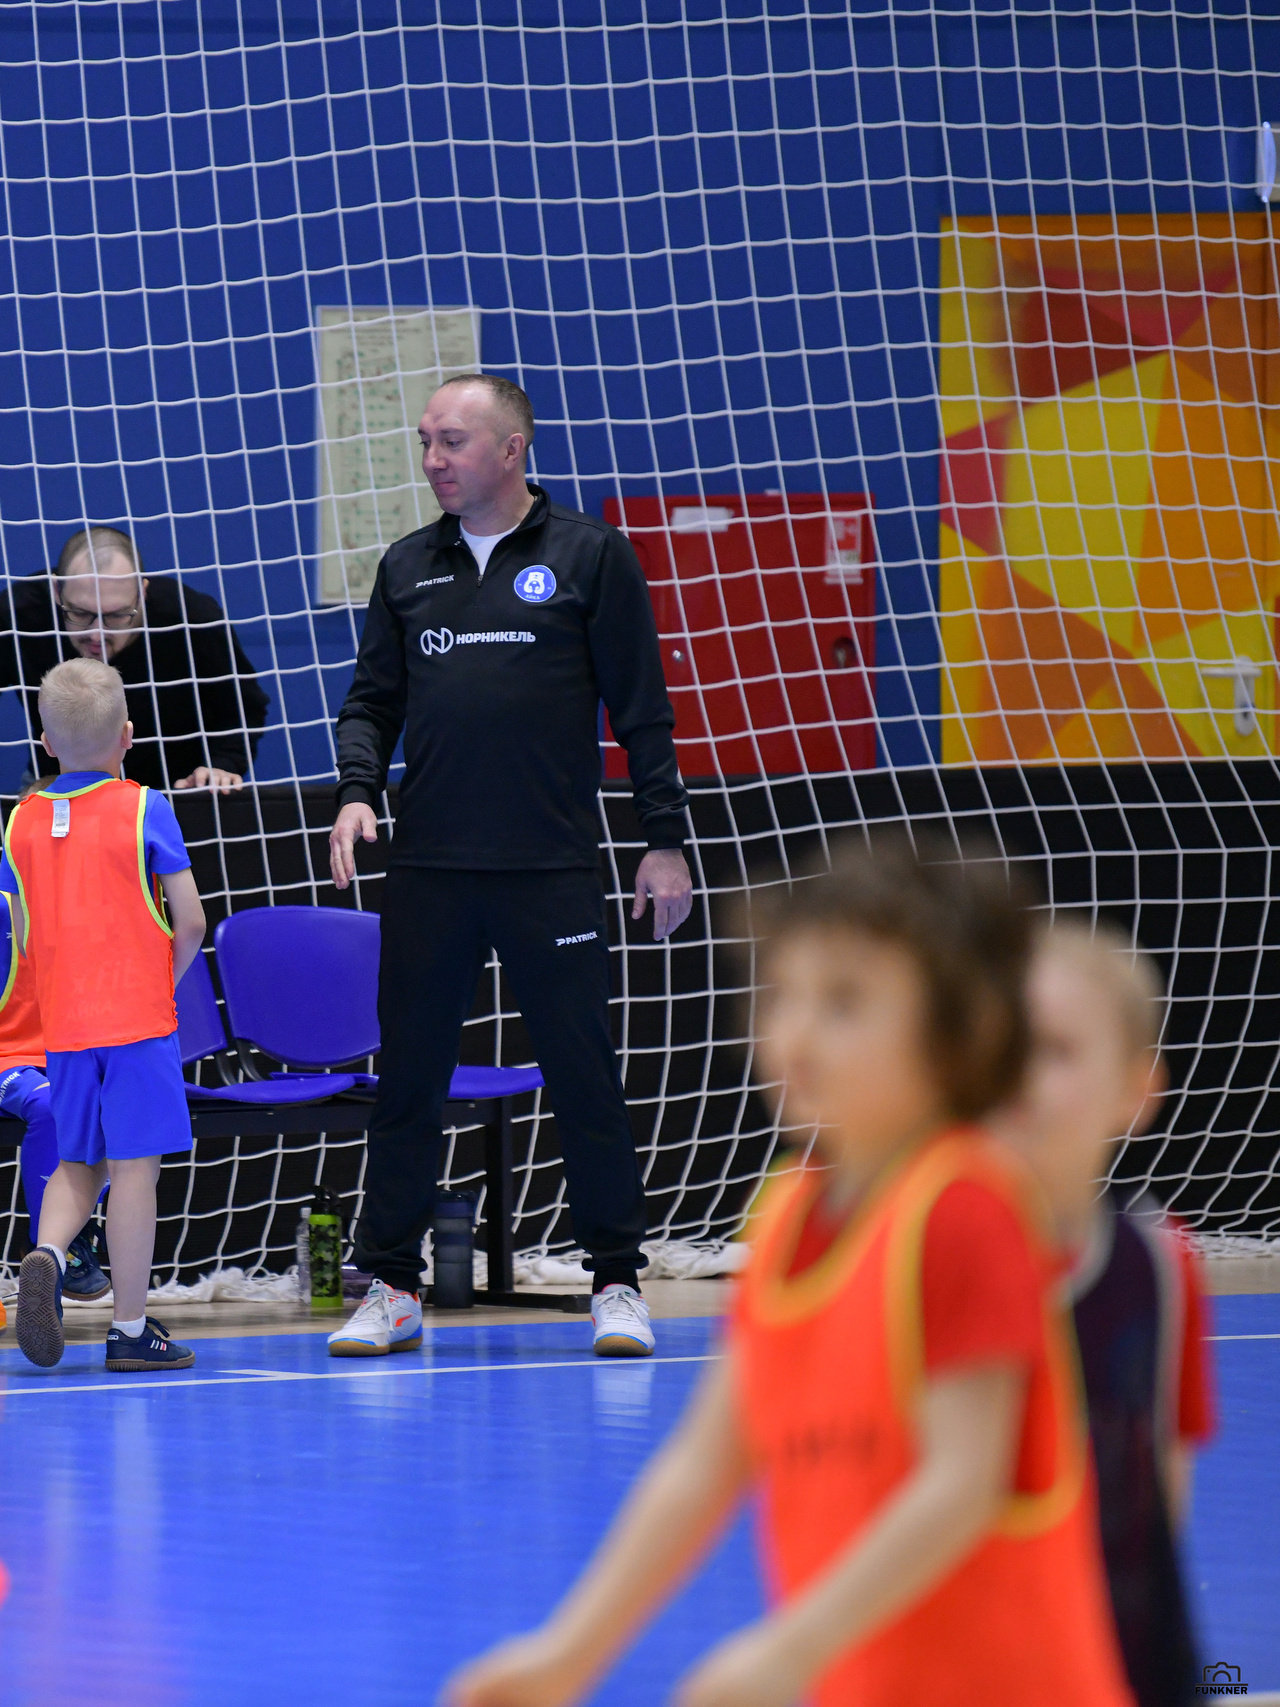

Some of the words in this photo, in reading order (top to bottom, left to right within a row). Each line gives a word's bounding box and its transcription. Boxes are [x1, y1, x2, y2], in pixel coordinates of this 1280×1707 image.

[423, 575, 454, 586] PATRICK
[456, 631, 536, 644] НОРНИКЕЛЬ
[565, 931, 598, 944] PATRICK
[0, 1071, 20, 1098] PATRICK
